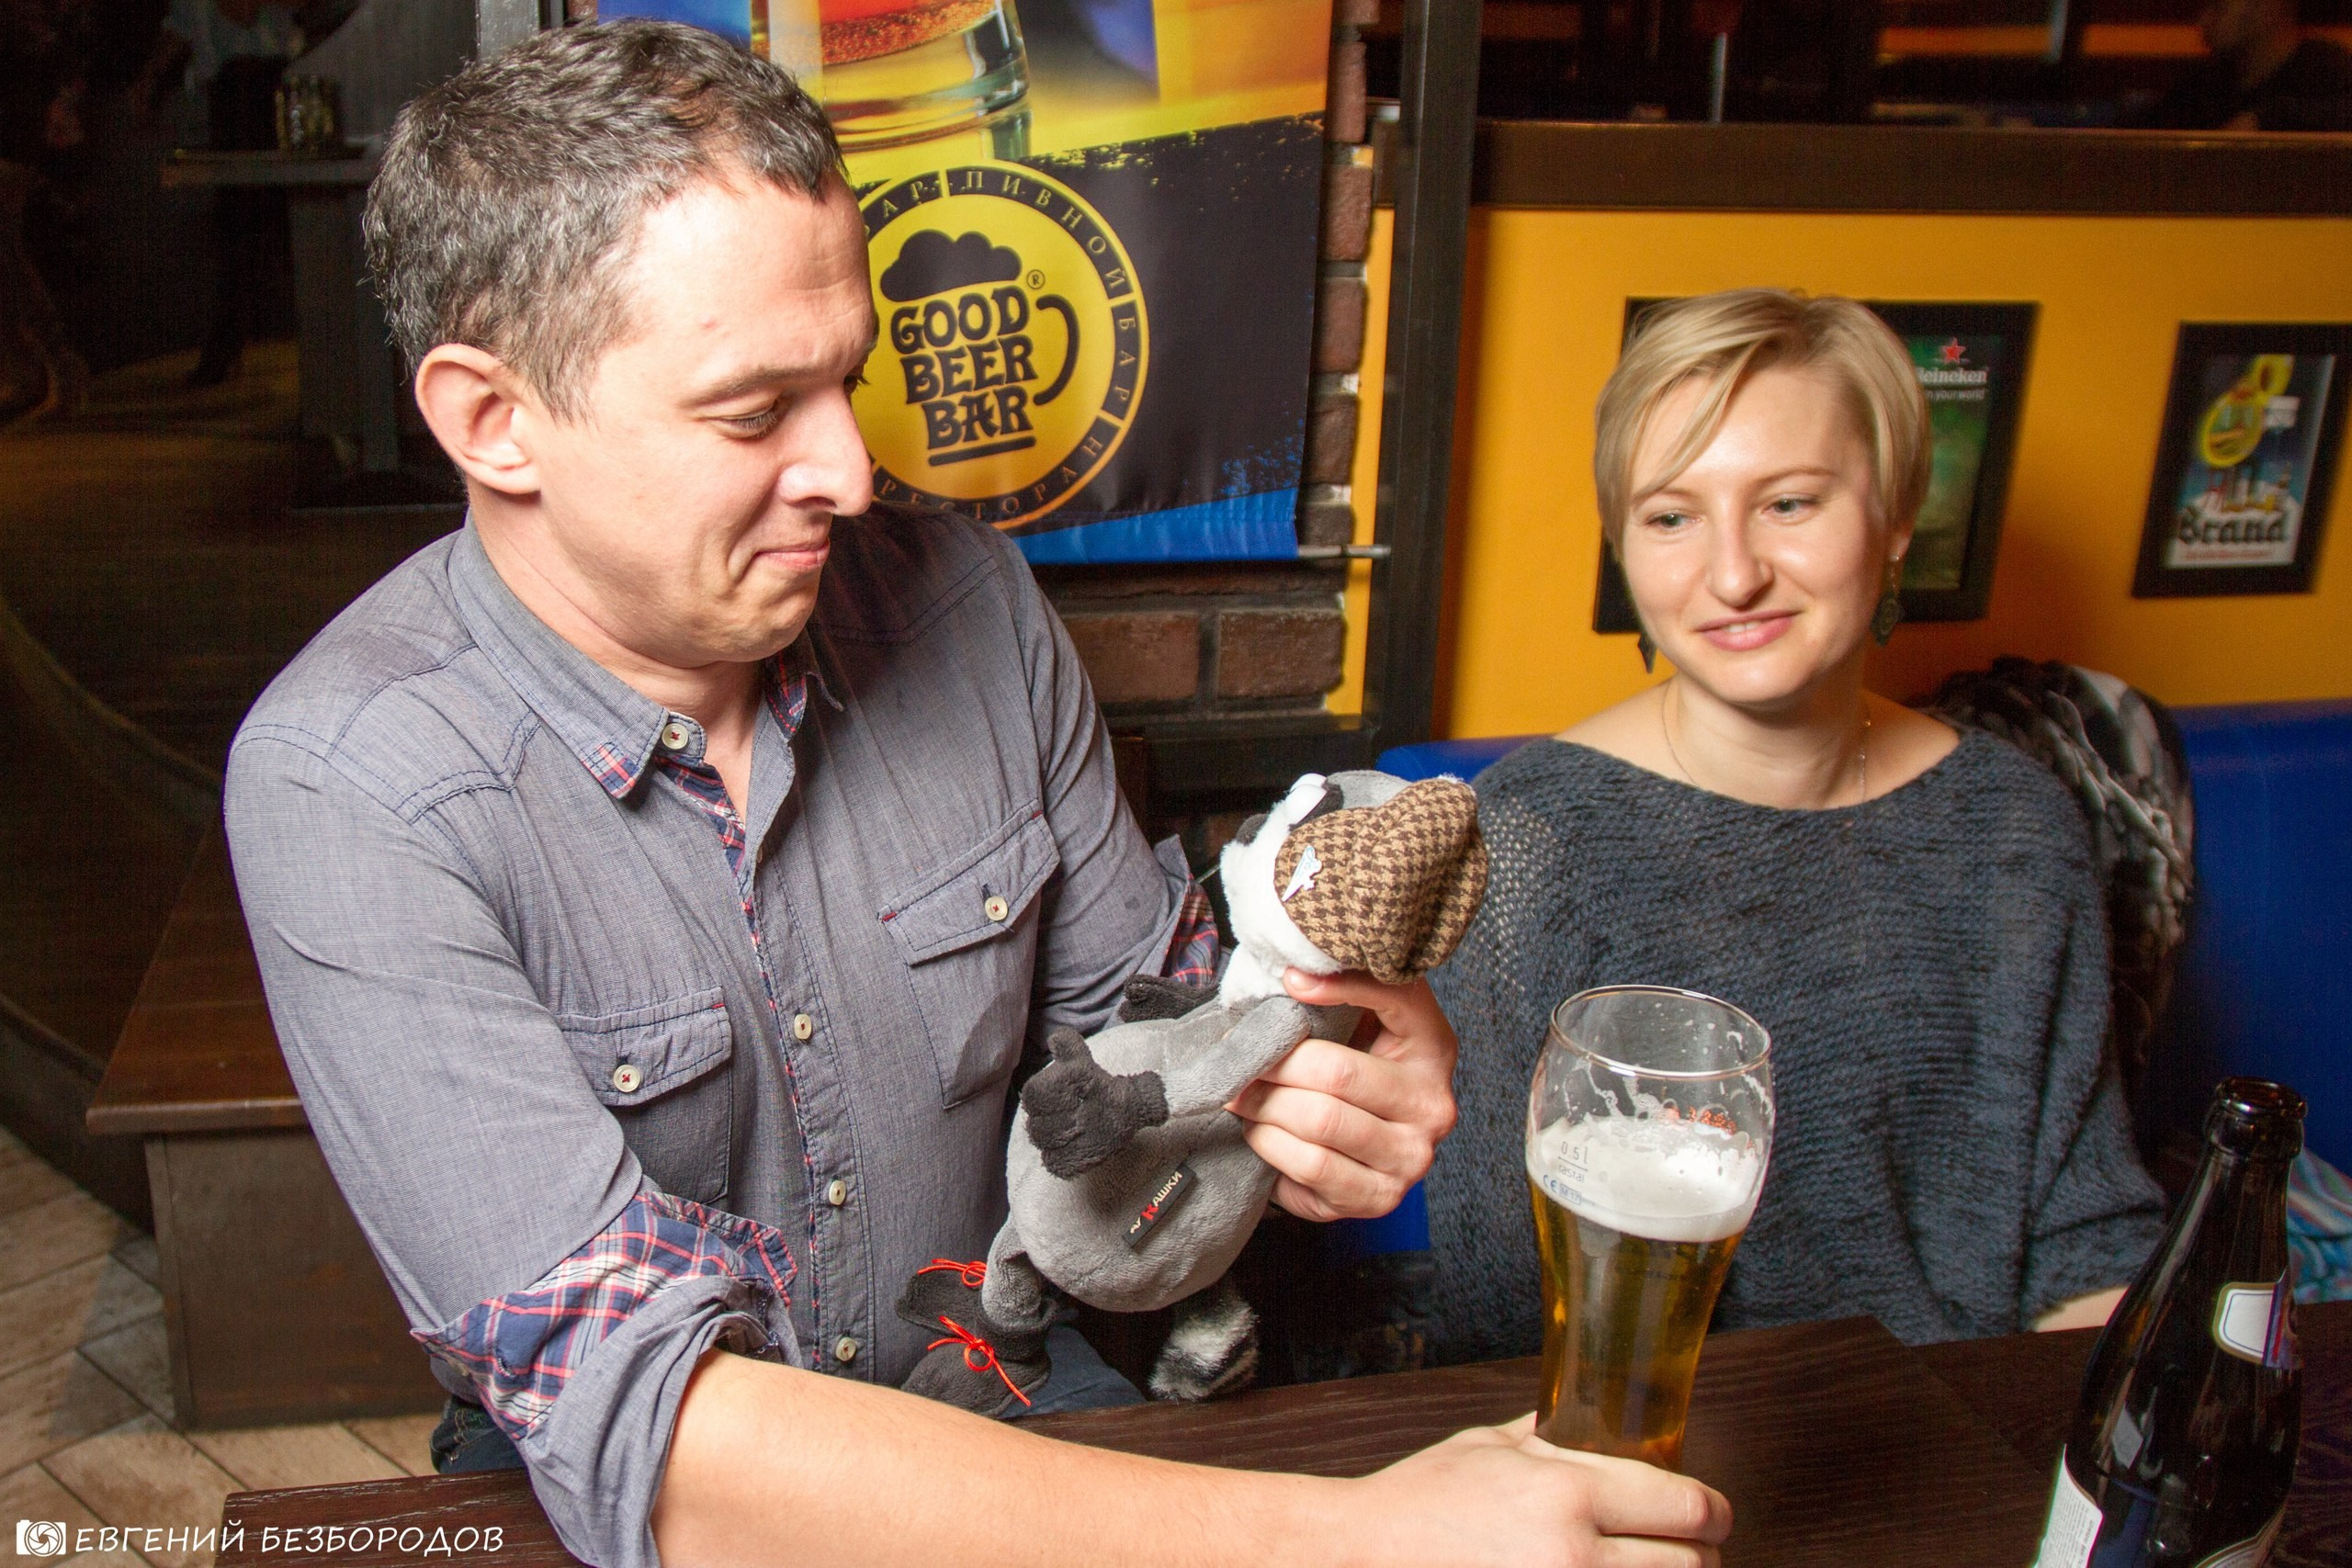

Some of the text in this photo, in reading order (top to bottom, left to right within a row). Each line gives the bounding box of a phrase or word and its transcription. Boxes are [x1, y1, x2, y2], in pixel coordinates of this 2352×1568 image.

[966, 170, 1125, 289] ПИВНОЙ
[890, 285, 1030, 355] GOOD
[899, 334, 1038, 405] BEER
[1114, 316, 1136, 401] БАР
[922, 385, 1034, 450] BAR
[2178, 507, 2286, 545] Brand
